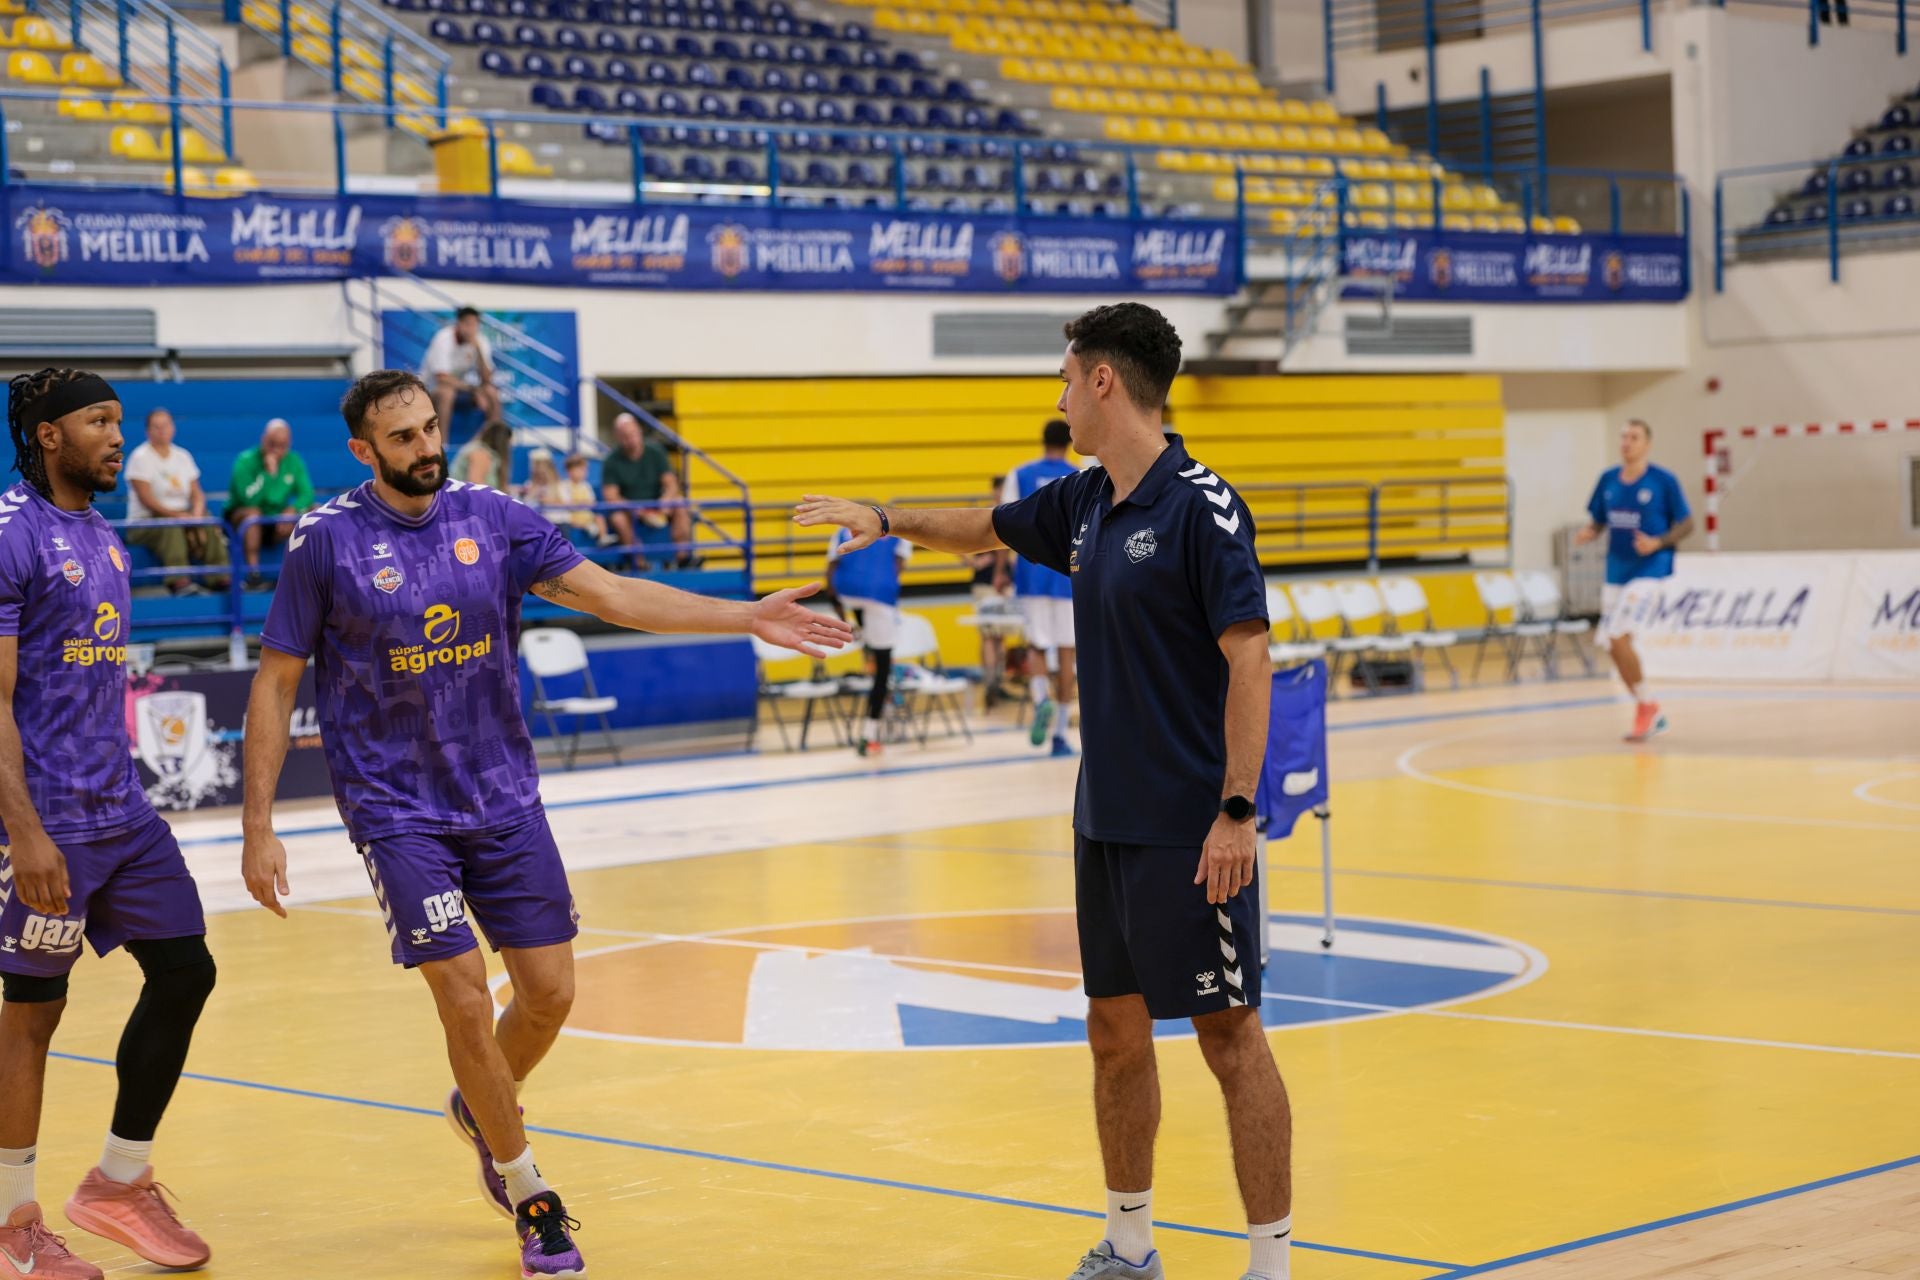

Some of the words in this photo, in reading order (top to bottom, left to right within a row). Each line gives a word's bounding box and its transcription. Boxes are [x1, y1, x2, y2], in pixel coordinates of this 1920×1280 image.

[80, 230, 209, 262] MELILLA
[571, 214, 690, 255] MELILLA
[868, 219, 975, 260] MELILLA
[436, 237, 553, 270] MELILLA
[756, 243, 854, 274] MELILLA
[1648, 586, 1810, 632] MELILLA
[389, 644, 424, 656] súper
[390, 633, 492, 674] agropal
[1196, 985, 1220, 996] hummel
